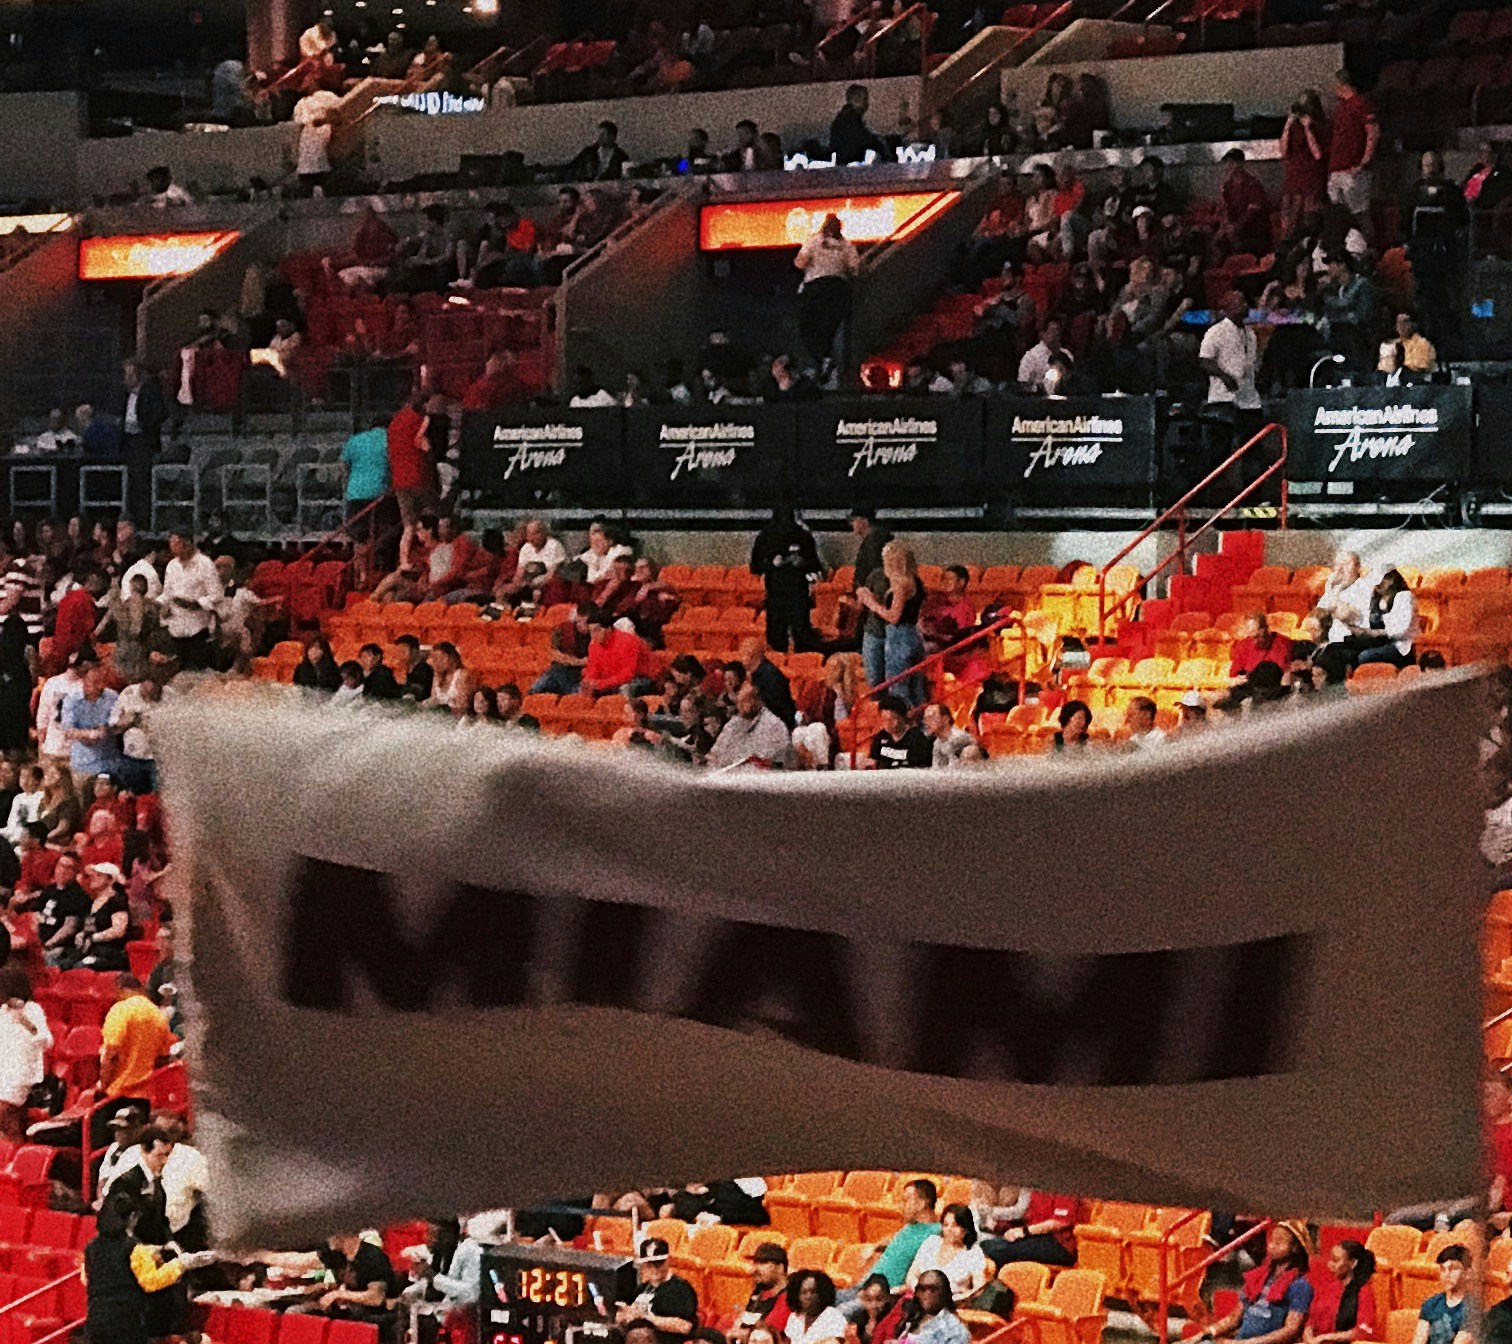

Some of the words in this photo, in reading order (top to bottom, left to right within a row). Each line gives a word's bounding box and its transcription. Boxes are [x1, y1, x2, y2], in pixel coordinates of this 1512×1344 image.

[1011, 415, 1123, 434] AmericanAirlines
[1313, 404, 1439, 426] AmericanAirlines
[503, 442, 567, 480] Arena
[670, 441, 737, 481] Arena
[847, 436, 919, 477] Arena
[1023, 435, 1103, 478] Arena
[1328, 426, 1416, 472] Arena
[282, 855, 1310, 1086] MIAMI
[519, 1267, 586, 1307] 12:27
